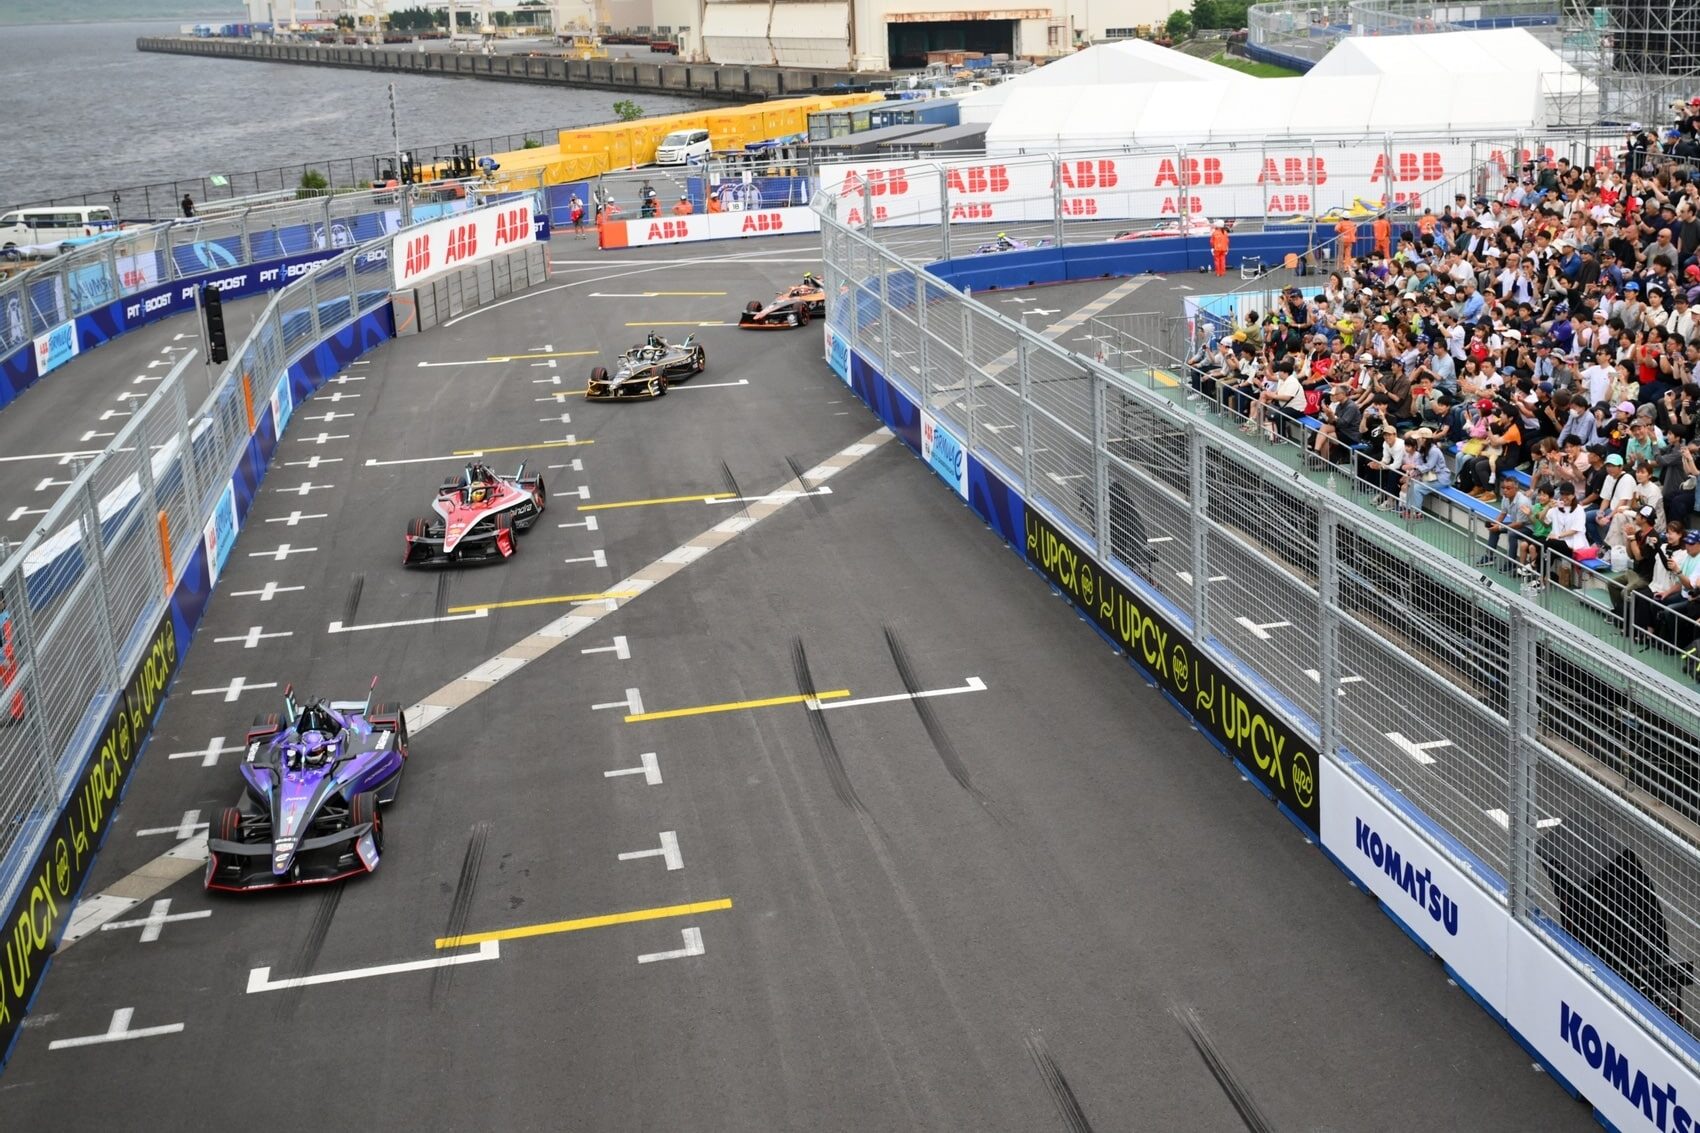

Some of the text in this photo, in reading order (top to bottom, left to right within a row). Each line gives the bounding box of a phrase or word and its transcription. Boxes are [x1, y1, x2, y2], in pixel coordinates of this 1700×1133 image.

[945, 164, 1010, 194] ABB
[1050, 159, 1118, 189] ABB
[1154, 158, 1224, 187] ABB
[1258, 157, 1328, 186] ABB
[1370, 152, 1444, 183] ABB
[841, 168, 909, 198] ABB
[847, 206, 888, 224] AB
[952, 202, 993, 219] ABB
[1062, 198, 1098, 215] ABB
[1268, 194, 1310, 212] ABB
[495, 207, 529, 247] ABB
[648, 220, 689, 241] ABB
[742, 213, 783, 233] ABB
[404, 234, 430, 279] ABB
[445, 223, 478, 265] ABB
[260, 269, 279, 283] PIT
[127, 292, 172, 320] PIT BOOST
[1041, 526, 1079, 596] UPCX
[1119, 594, 1169, 679] UPCX
[141, 631, 169, 715] UPCX
[1221, 684, 1286, 790] UPCX
[85, 728, 122, 833] UPCX
[1356, 816, 1459, 937] KOMATSU
[7, 861, 58, 998] UPCX
[1560, 1000, 1700, 1133] KOMATS
